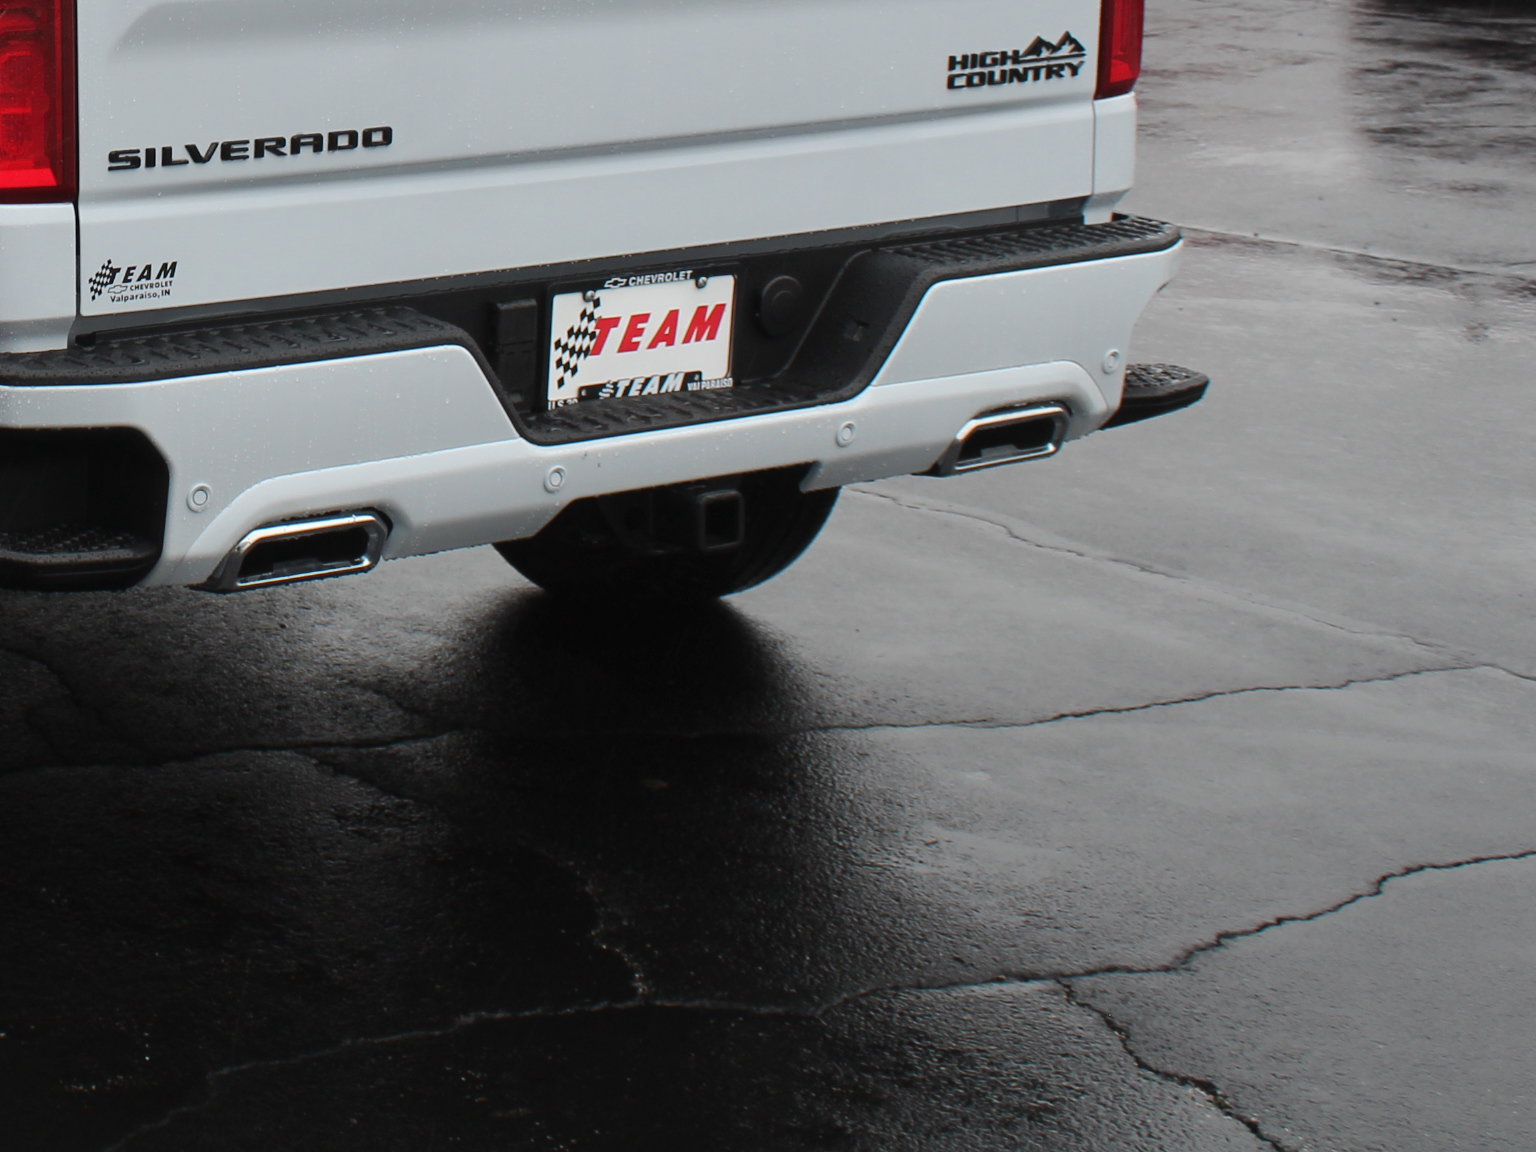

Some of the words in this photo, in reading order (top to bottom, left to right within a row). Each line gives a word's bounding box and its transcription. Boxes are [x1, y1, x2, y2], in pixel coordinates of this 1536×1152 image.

[948, 49, 1020, 71] HIGH
[946, 61, 1085, 89] COUNTRY
[107, 126, 393, 171] SILVERADO
[108, 261, 177, 285] TEAM
[129, 280, 173, 291] CHEVROLET
[628, 270, 694, 286] CHEVROLET
[588, 303, 726, 356] TEAM
[614, 371, 686, 398] TEAM
